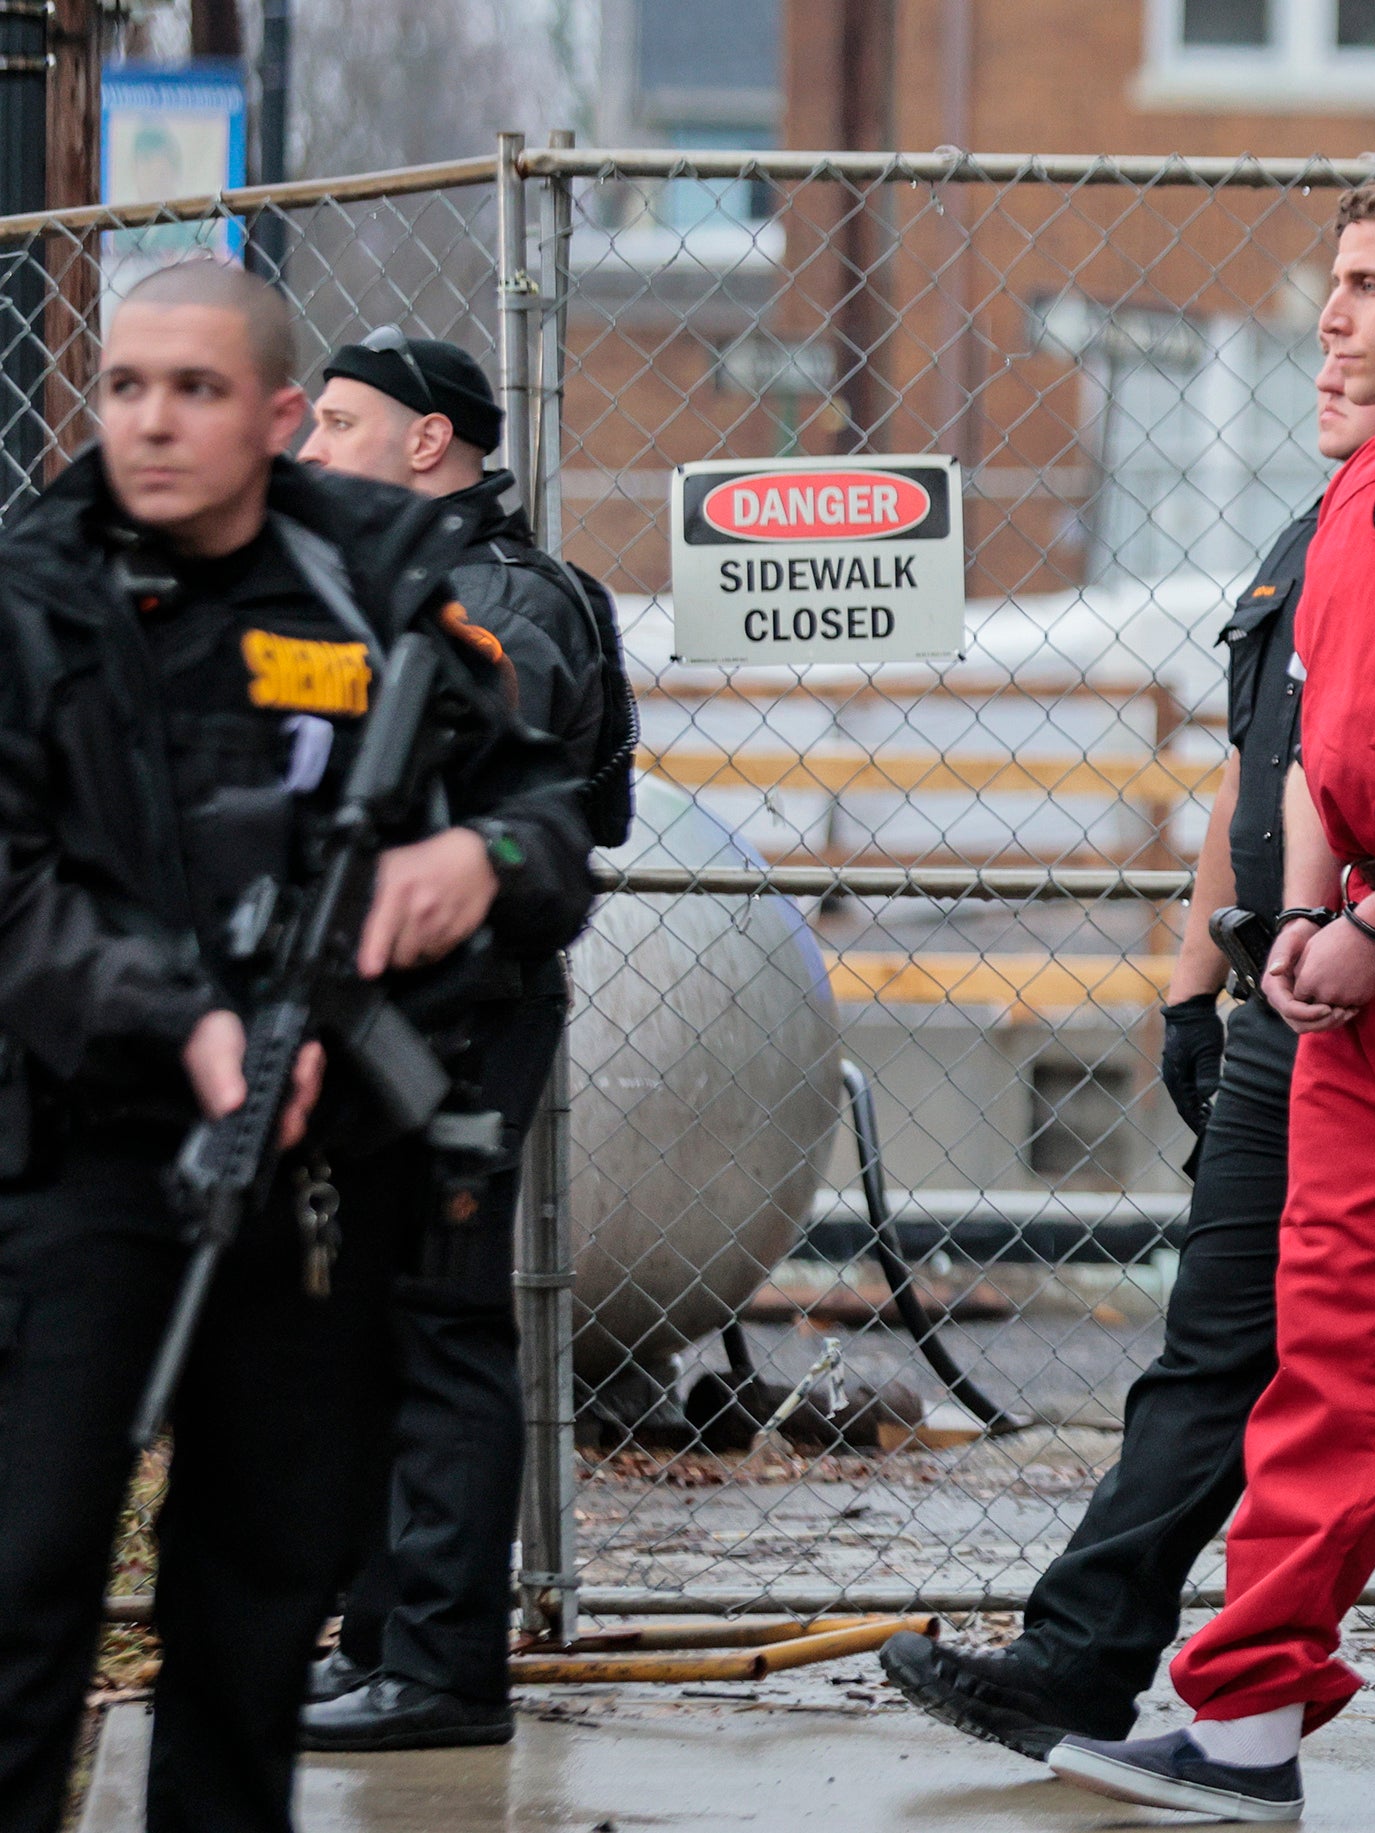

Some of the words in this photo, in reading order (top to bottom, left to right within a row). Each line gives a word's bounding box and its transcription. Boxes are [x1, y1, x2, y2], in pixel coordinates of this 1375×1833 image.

[733, 484, 899, 527] DANGER
[719, 554, 918, 593] SIDEWALK
[743, 606, 896, 642] CLOSED
